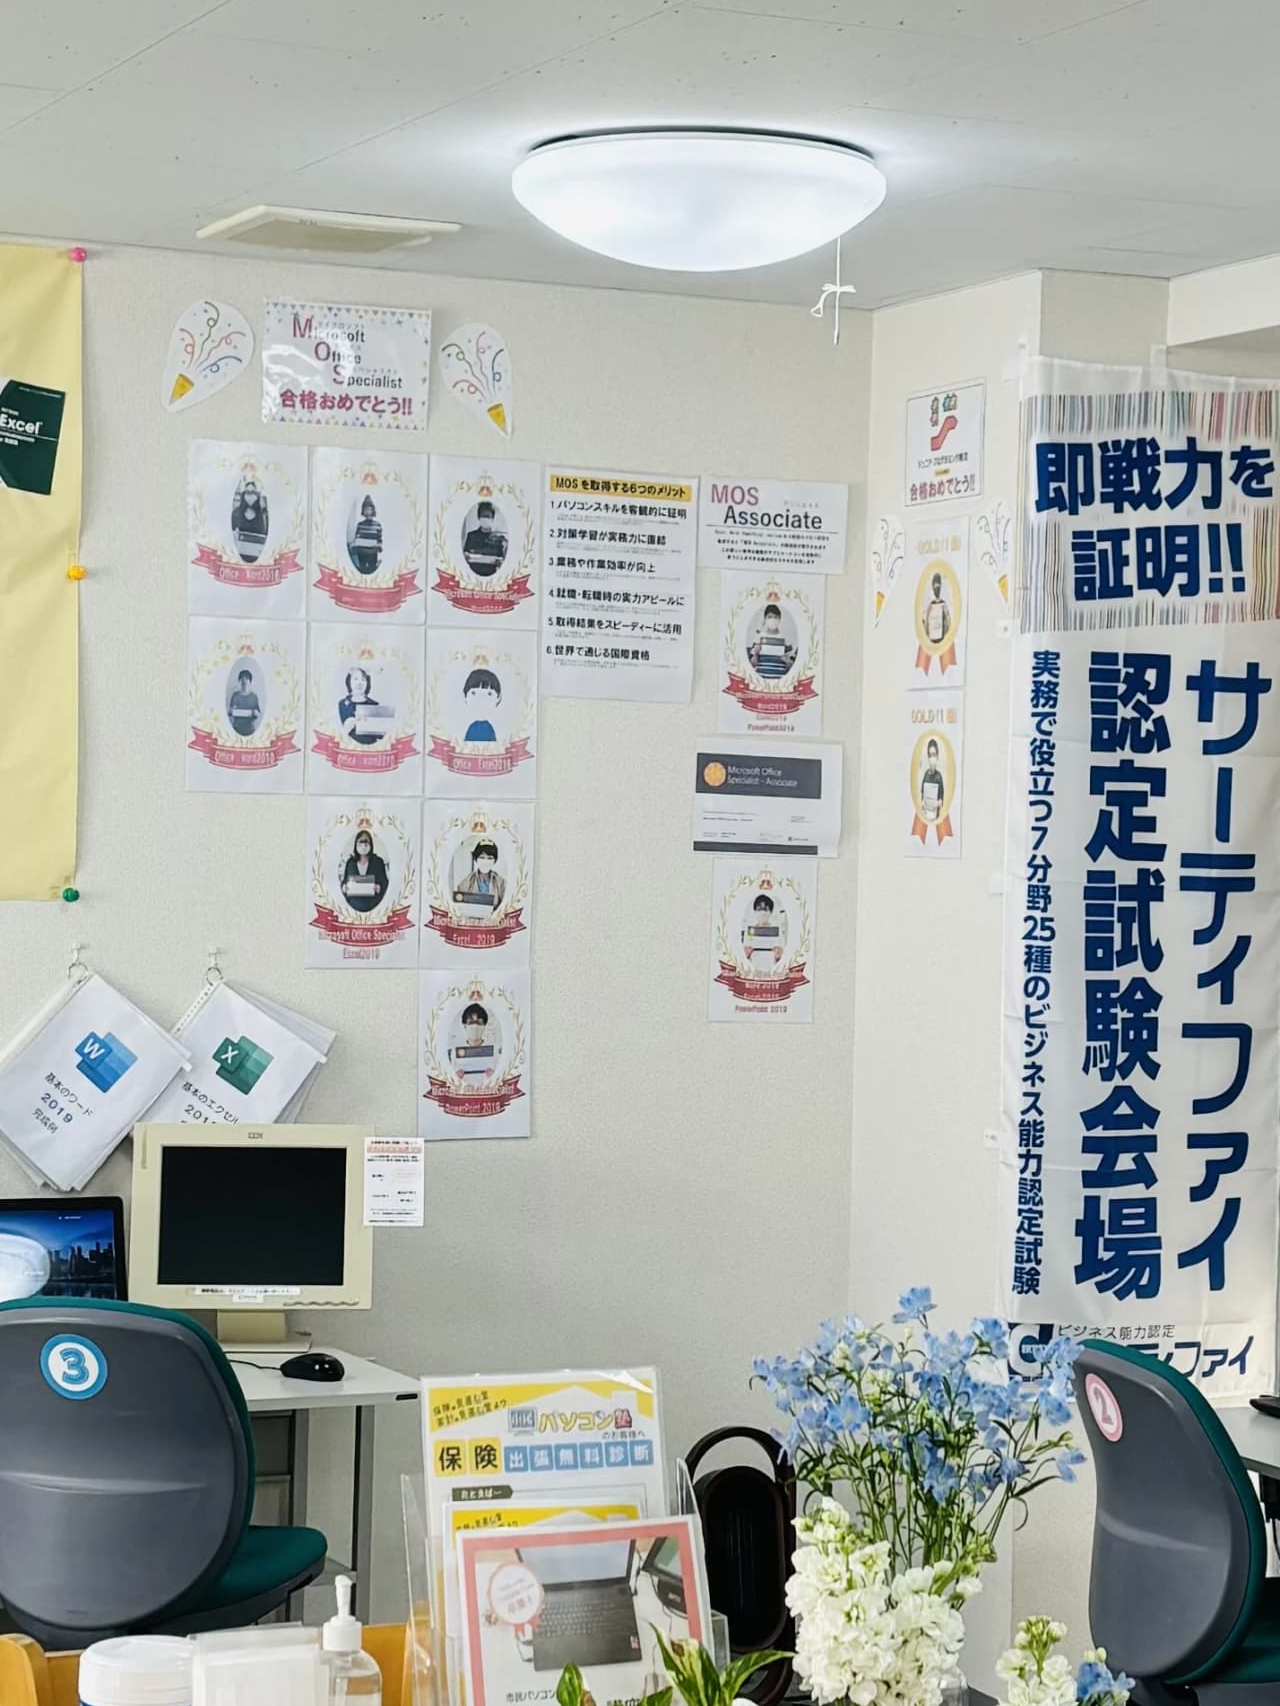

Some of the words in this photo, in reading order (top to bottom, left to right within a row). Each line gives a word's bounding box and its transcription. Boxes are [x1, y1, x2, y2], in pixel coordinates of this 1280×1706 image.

[280, 389, 413, 416] 合格おめでとう!!
[0, 413, 42, 435] Excel
[710, 483, 759, 506] MOS
[1033, 435, 1276, 516] 即戦力を
[723, 505, 823, 530] Associate
[1071, 522, 1247, 601] 証明!!
[1012, 650, 1061, 1296] 実務で役立つ7分野25種のビジネス能力認定試験
[1074, 650, 1172, 1302] 認定試験会場
[1177, 659, 1273, 1291] サーティファイ
[82, 1038, 105, 1060] W
[220, 1045, 239, 1064] X
[44, 1071, 95, 1118] 基本のワード
[181, 1081, 240, 1124] 基本のエクセル
[183, 1104, 217, 1124] 201
[60, 1348, 89, 1386] 3
[1092, 1385, 1114, 1426] 2
[438, 1444, 498, 1471] 保険
[508, 1443, 650, 1469] 出張無料診断
